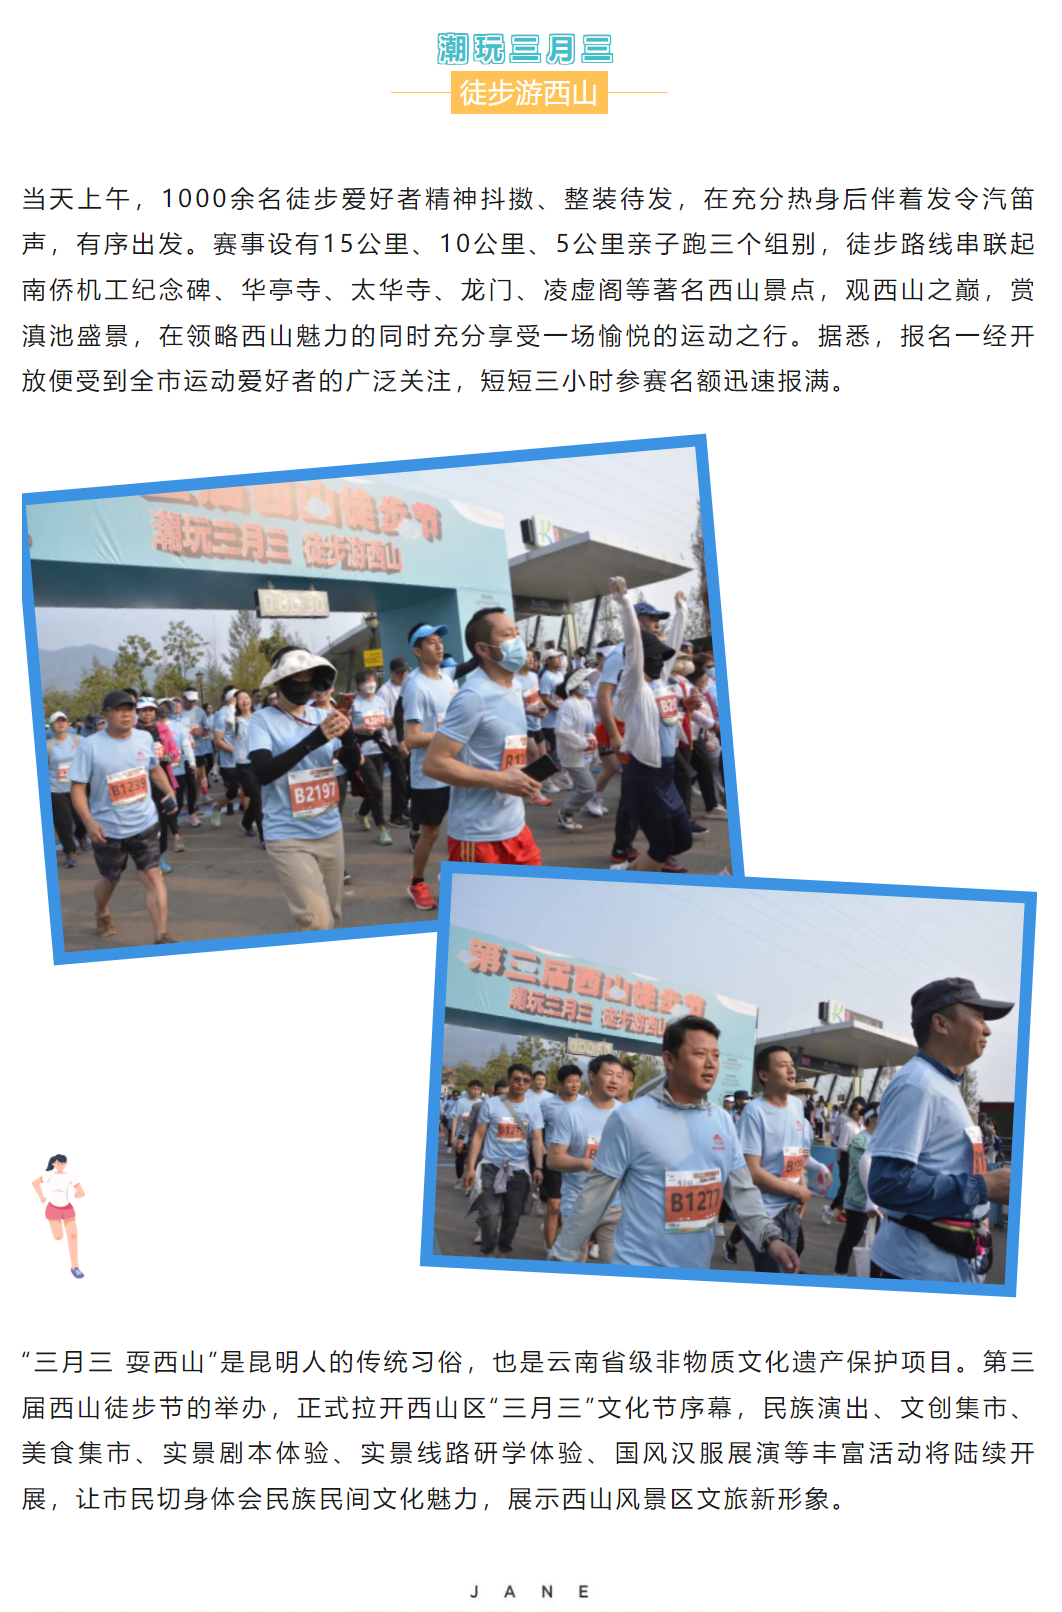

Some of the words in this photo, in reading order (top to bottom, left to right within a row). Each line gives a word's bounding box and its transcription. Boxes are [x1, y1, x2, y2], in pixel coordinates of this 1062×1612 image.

[150, 510, 292, 565] 潮玩三月三
[302, 529, 404, 574] 徒步游西山
[111, 778, 147, 797] B1239
[294, 782, 337, 805] B2197
[467, 938, 707, 1019] 第三届西山徒步节
[508, 984, 594, 1025] 潮玩三月三
[671, 1187, 721, 1213] B1277
